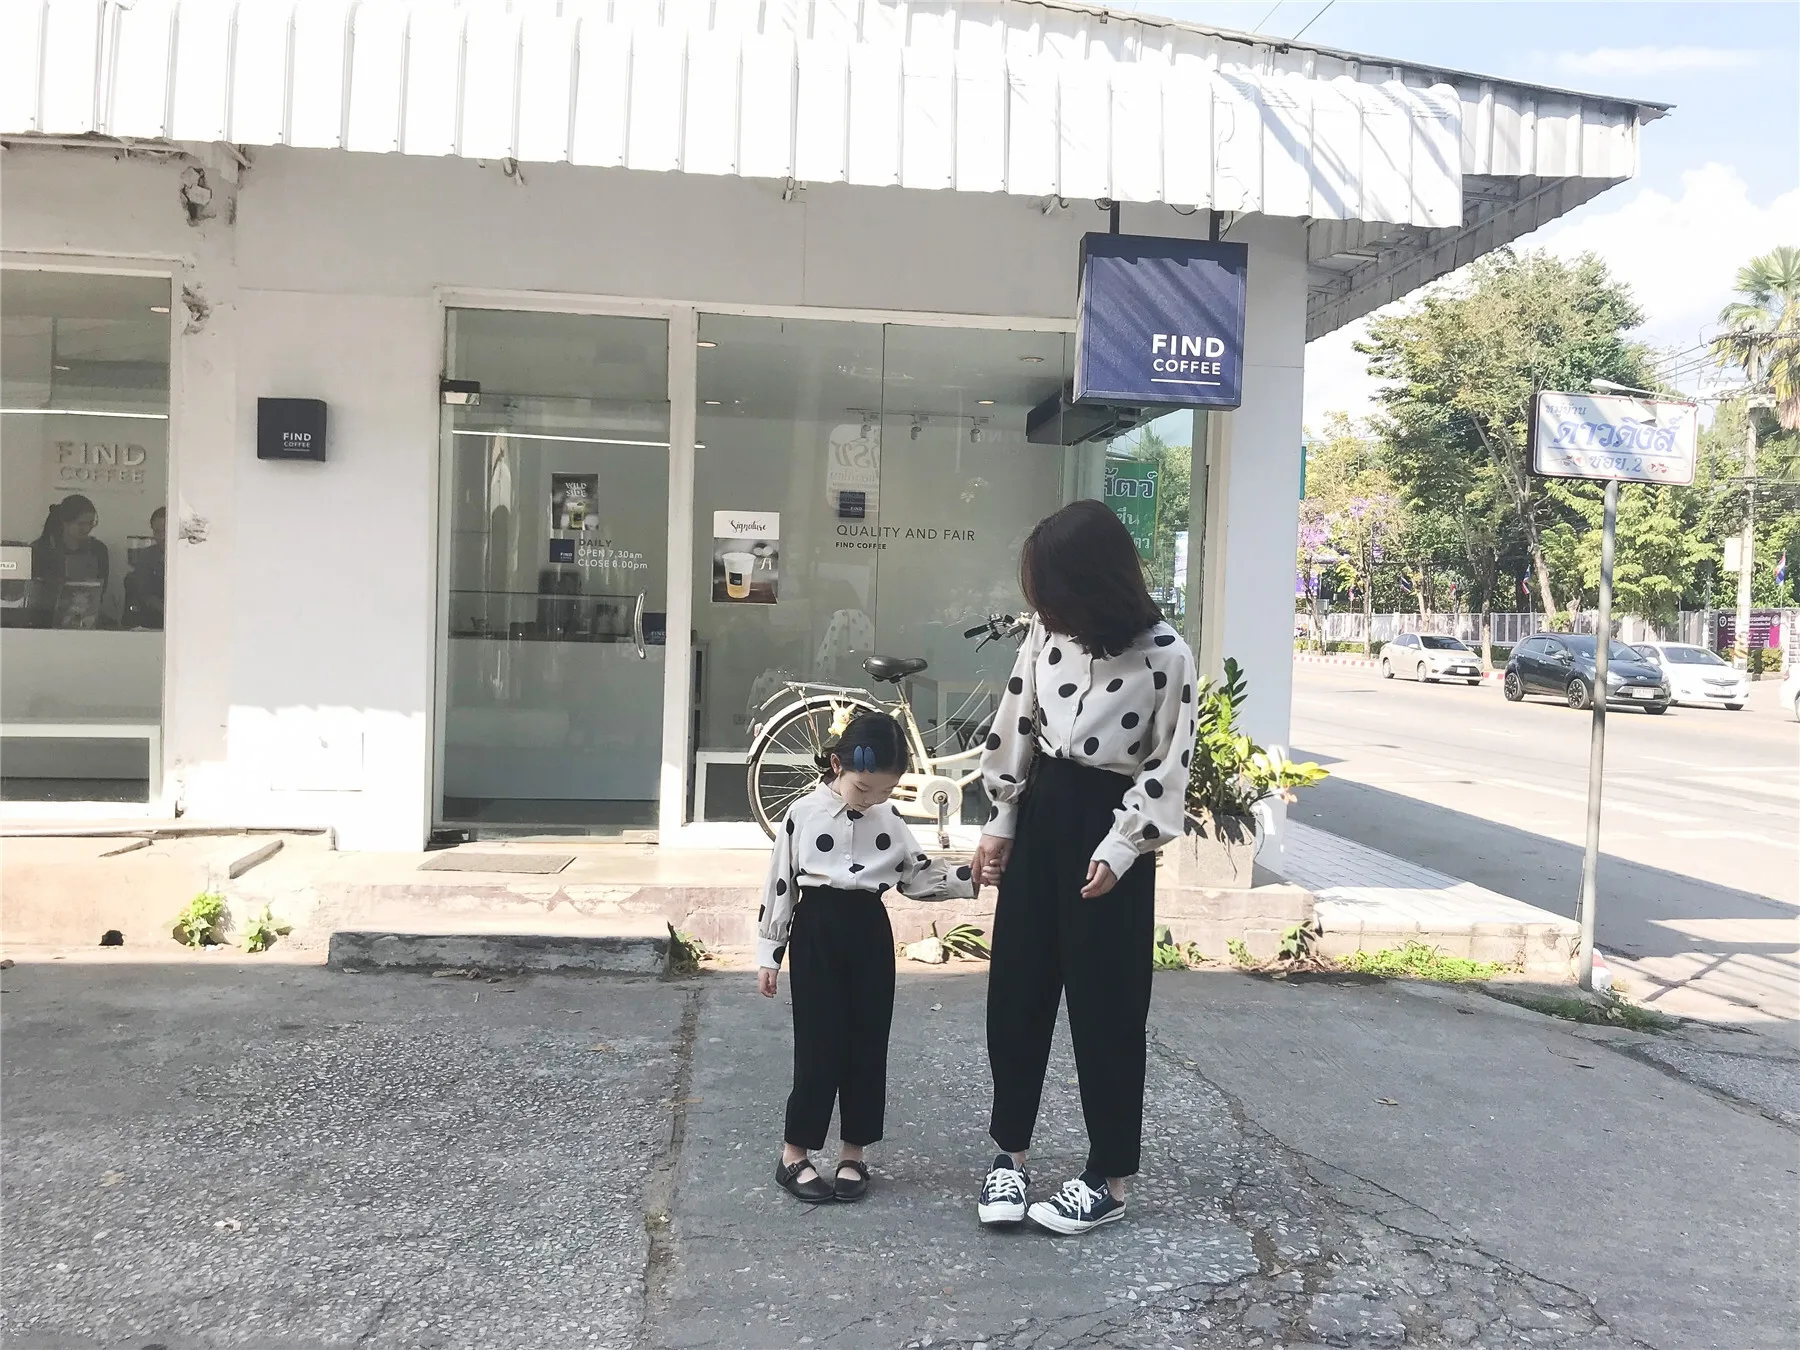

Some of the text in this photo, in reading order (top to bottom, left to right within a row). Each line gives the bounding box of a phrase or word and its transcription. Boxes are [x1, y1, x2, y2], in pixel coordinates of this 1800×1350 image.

[1152, 333, 1225, 358] FIND
[1153, 358, 1221, 375] COFFEE
[1545, 402, 1587, 417] หมู่บ้าน
[283, 432, 312, 441] FIND
[56, 441, 146, 466] FIND
[60, 466, 145, 483] COFFEE
[565, 482, 587, 490] WILD
[566, 489, 587, 498] SIDE
[729, 519, 767, 533] Signature
[836, 524, 975, 541] QUALITY AND FAIR
[578, 539, 612, 547] DAILY
[856, 542, 887, 550] COFFEE
[578, 549, 605, 557] OPEN
[577, 559, 610, 568] CLOSE
